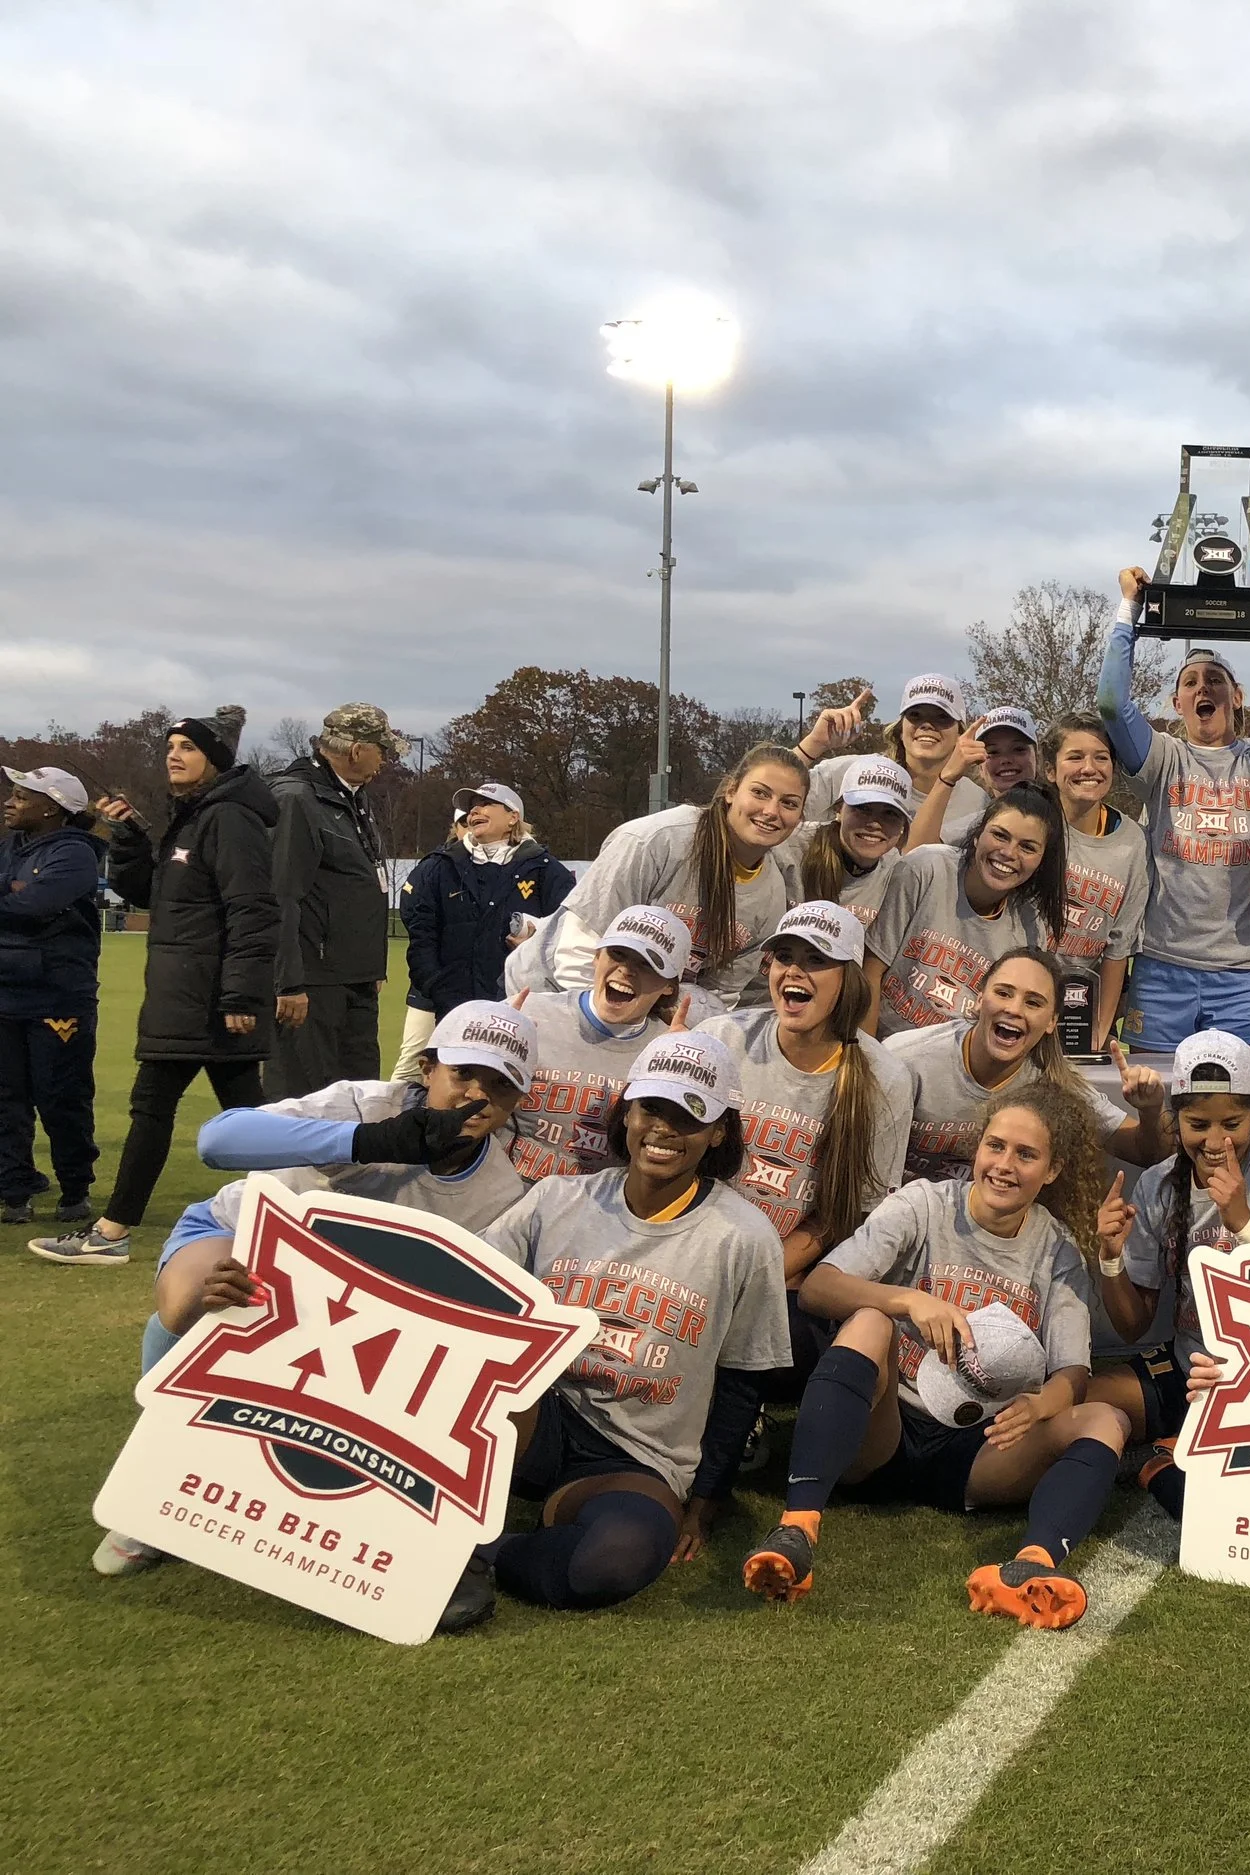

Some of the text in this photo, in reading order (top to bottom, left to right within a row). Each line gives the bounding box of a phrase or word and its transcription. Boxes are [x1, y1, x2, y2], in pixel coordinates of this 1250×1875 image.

[1201, 547, 1234, 562] XII
[909, 685, 955, 704] CHAMPIONS
[858, 775, 908, 799] CHAMPIONS
[1174, 810, 1248, 834] 20 XII 18
[1068, 862, 1126, 893] CONFERENC
[639, 911, 668, 932] XII
[801, 905, 829, 918] XII
[1085, 915, 1104, 932] 18
[617, 920, 676, 954] CHAMPIONS
[780, 915, 841, 938] CHAMPIONS
[921, 928, 939, 940] BIG
[946, 938, 991, 970] CONFERE
[902, 935, 985, 997] SOCCE
[908, 966, 928, 991] 20
[926, 976, 960, 1008] XII
[1064, 988, 1087, 1003] XII
[487, 1015, 519, 1038] XII
[462, 1028, 529, 1062] CHAMPIONS
[670, 1043, 706, 1065] XII
[535, 1069, 560, 1081] BIG
[567, 1071, 582, 1083] 12
[648, 1059, 717, 1088] CHAMPIONS
[1203, 1053, 1238, 1072] CHAMPIONS
[521, 1082, 620, 1117] SOC
[535, 1118, 563, 1145] 20
[750, 1100, 825, 1135] 12 CONFER
[940, 1122, 954, 1131] 12
[744, 1157, 817, 1202] XII 18
[551, 1258, 708, 1312] BIG 12 CONFERENCE
[944, 1265, 959, 1277] 12
[206, 1238, 532, 1480] XII
[591, 1324, 670, 1369] XII 18
[233, 1408, 417, 1491] CHAMPIONSHIP
[179, 1473, 395, 1574] 2018 BIG 12
[159, 1501, 385, 1601] SOCCER CHAMPIONS
